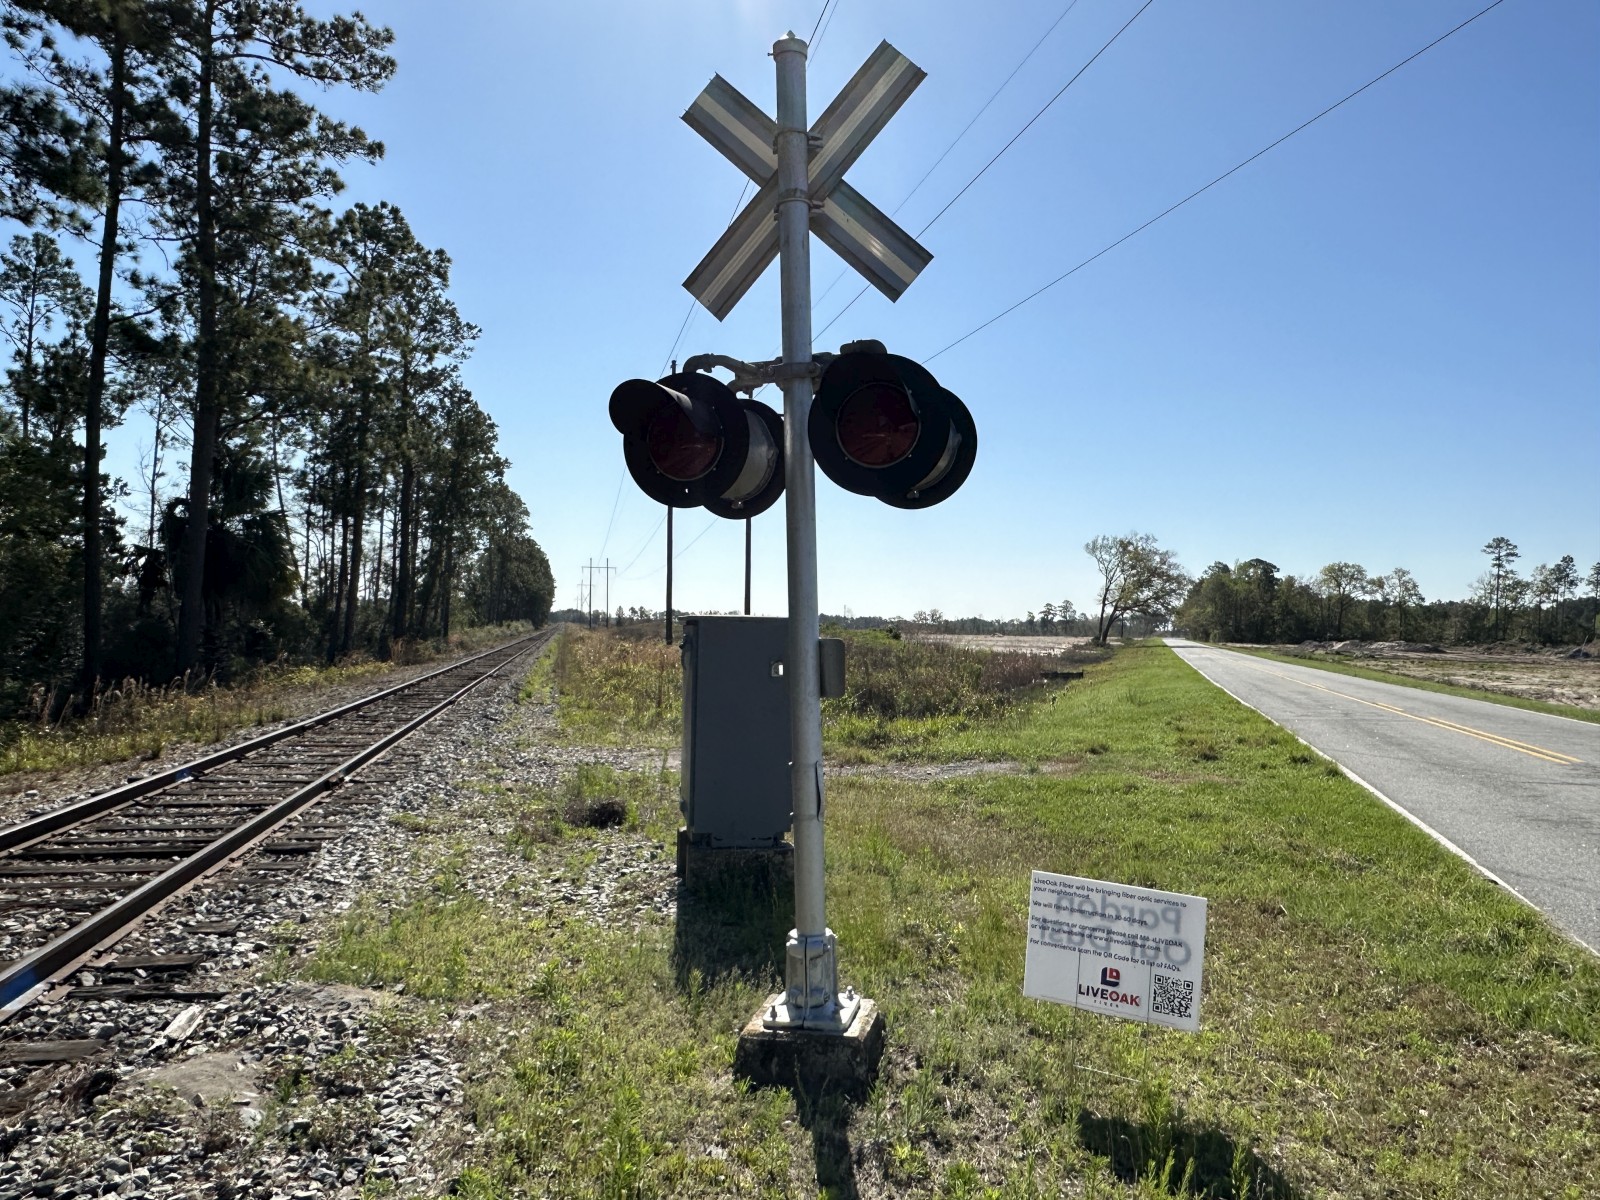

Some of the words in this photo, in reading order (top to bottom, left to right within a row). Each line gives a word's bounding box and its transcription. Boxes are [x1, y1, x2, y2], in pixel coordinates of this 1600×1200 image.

[1034, 877, 1057, 886] LiveOak
[1095, 887, 1120, 897] bringing
[1154, 897, 1179, 906] services
[1078, 984, 1140, 1006] LIVEOAK
